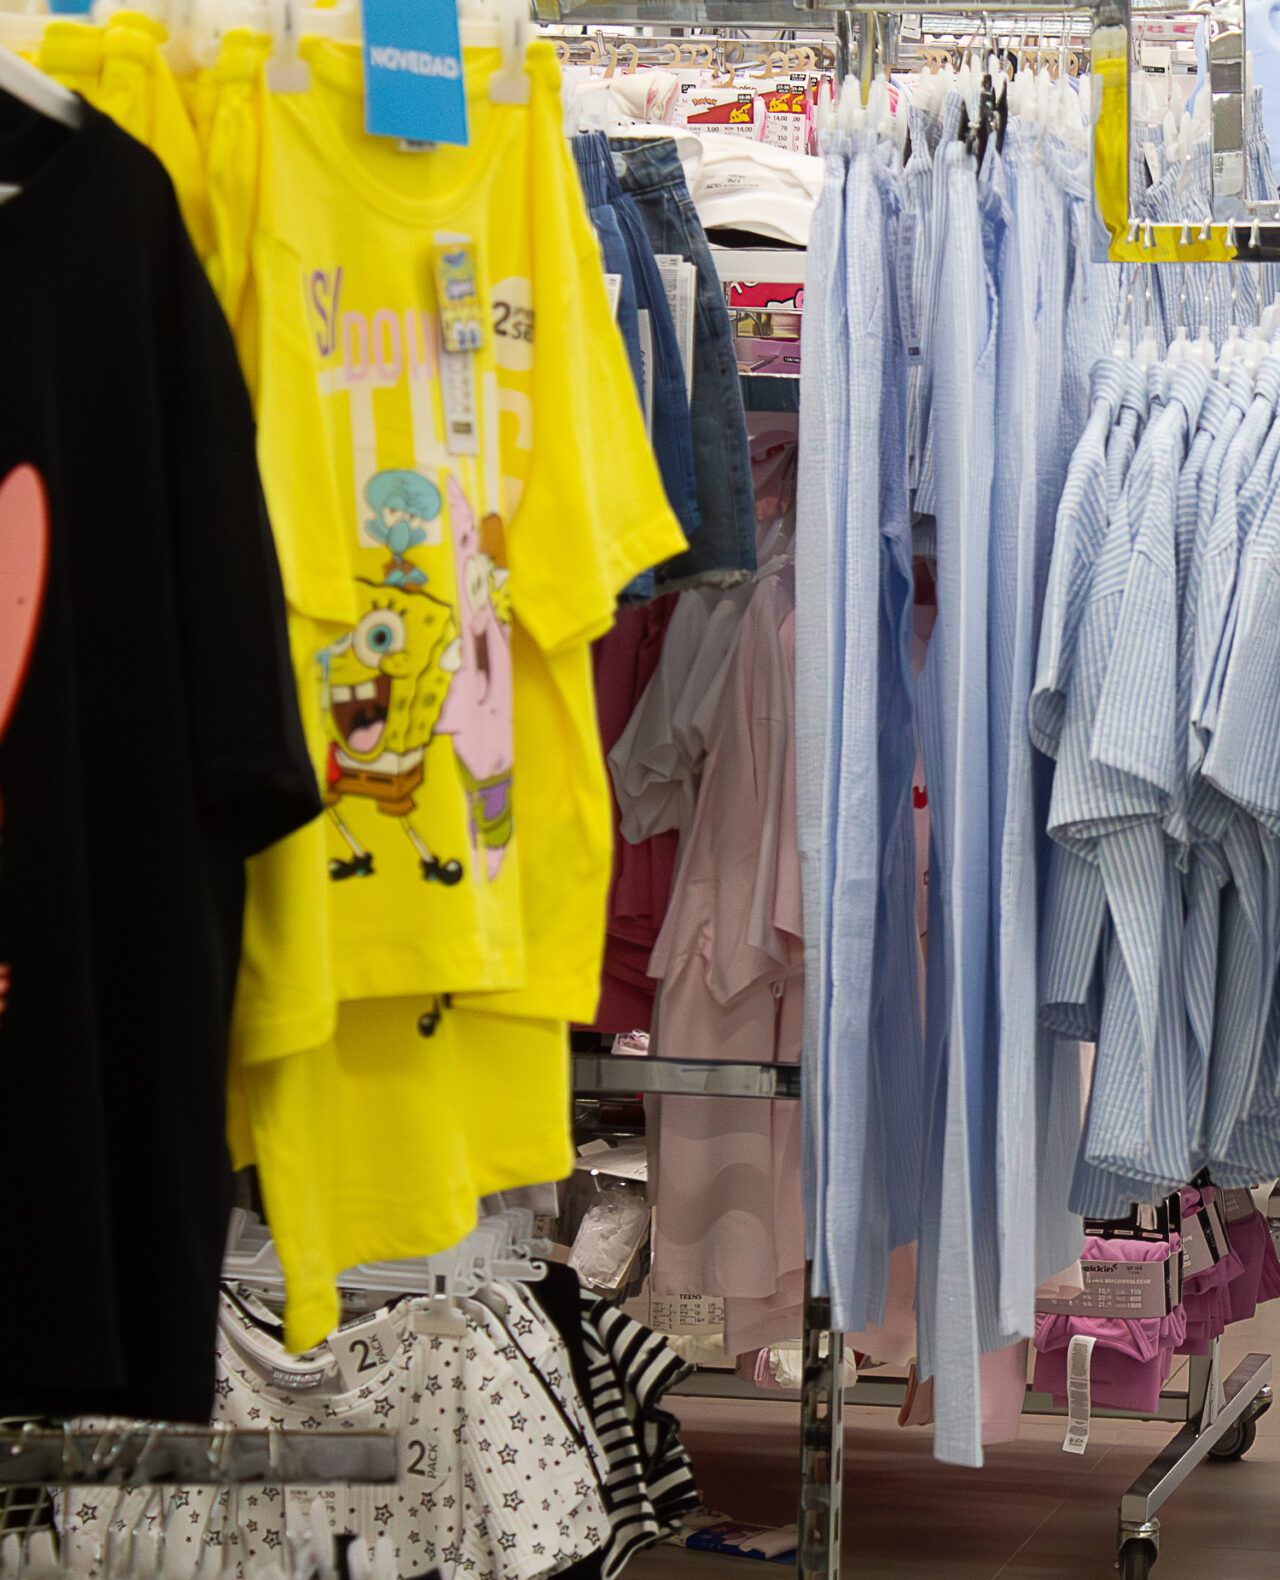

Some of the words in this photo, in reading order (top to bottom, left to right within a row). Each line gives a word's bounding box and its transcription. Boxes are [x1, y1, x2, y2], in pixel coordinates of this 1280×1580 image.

[370, 45, 459, 80] NOVEDAD
[492, 301, 512, 336] 2
[350, 1339, 377, 1373] 2
[368, 1333, 389, 1365] PACK
[406, 1439, 426, 1477] 2
[427, 1442, 438, 1479] PACK
